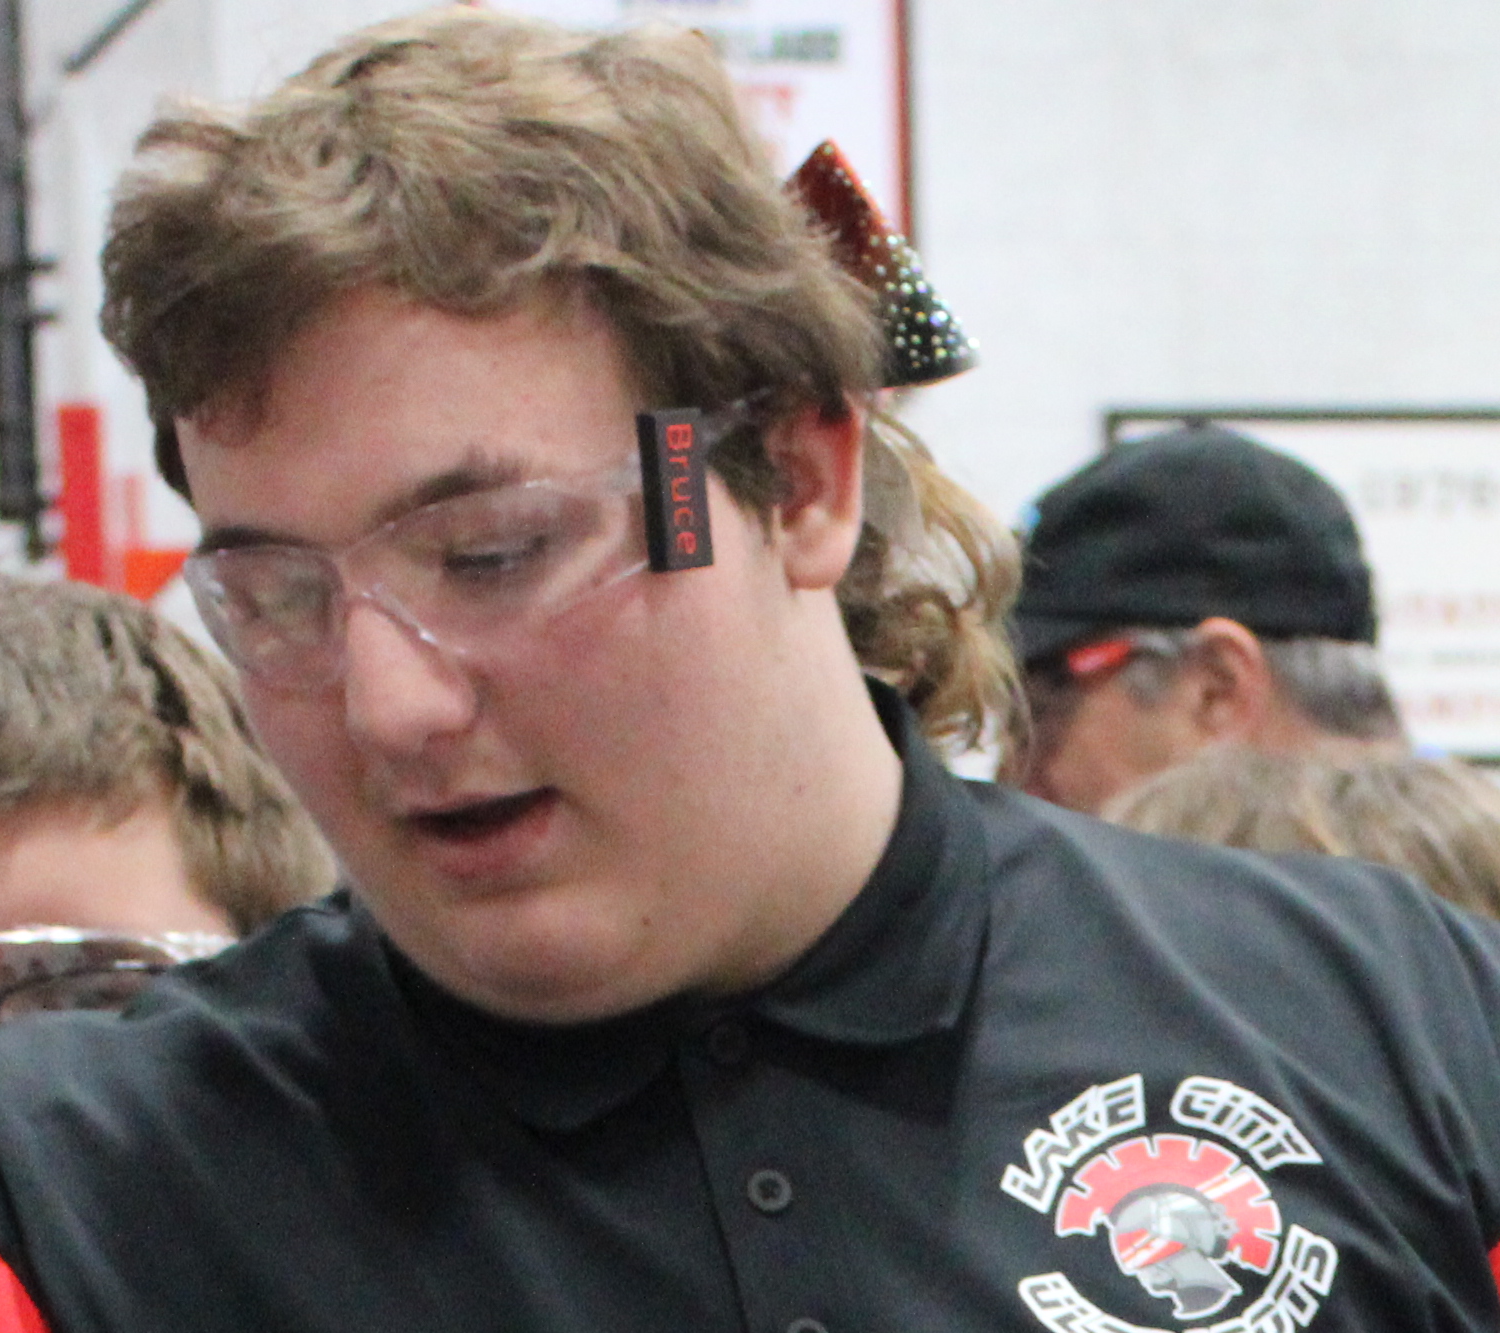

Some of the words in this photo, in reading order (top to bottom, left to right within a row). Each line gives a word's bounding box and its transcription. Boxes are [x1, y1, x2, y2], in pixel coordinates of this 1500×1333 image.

[663, 421, 700, 556] Bruce
[1000, 1073, 1146, 1214] LAKE
[1169, 1074, 1324, 1173] CITY
